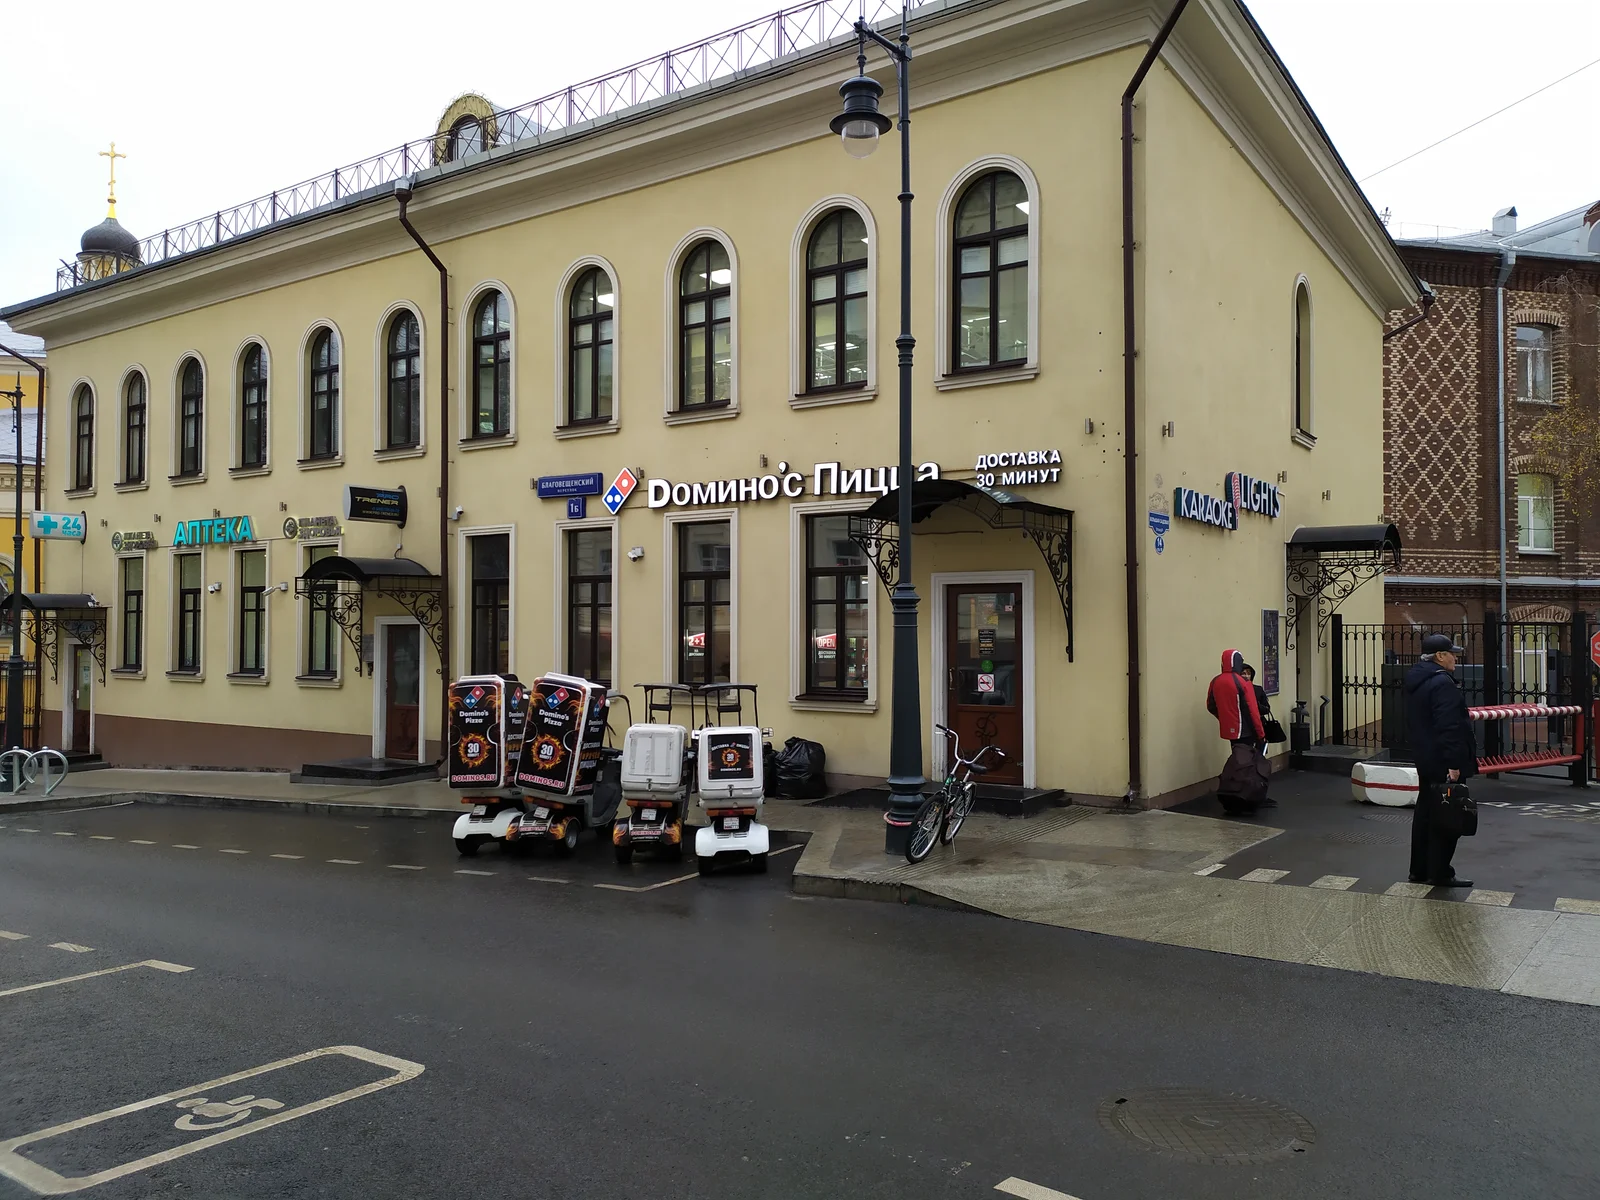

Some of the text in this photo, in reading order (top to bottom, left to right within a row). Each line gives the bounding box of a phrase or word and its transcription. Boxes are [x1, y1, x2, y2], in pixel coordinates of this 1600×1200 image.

[975, 449, 1062, 471] ДОСТАВКА
[541, 477, 594, 489] БЛАГОВЕЩЕНСКИЙ
[976, 468, 1061, 487] 30 МИНУТ
[355, 496, 399, 506] TRENER
[1181, 472, 1281, 530] KARAOKE LIGHTS
[570, 503, 580, 513] 1Б
[61, 516, 82, 530] 24
[61, 529, 82, 537] часа
[173, 515, 254, 546] АПТЕКА
[688, 636, 705, 646] 2+1
[818, 638, 836, 648] OPEN
[459, 709, 489, 717] Domino's
[538, 708, 570, 721] Domino's
[544, 717, 562, 727] Pizza
[467, 742, 480, 753] 30
[541, 743, 553, 756] 30
[451, 773, 497, 783] DOMINOS.RU
[518, 772, 565, 789] DOMINOS.RU
